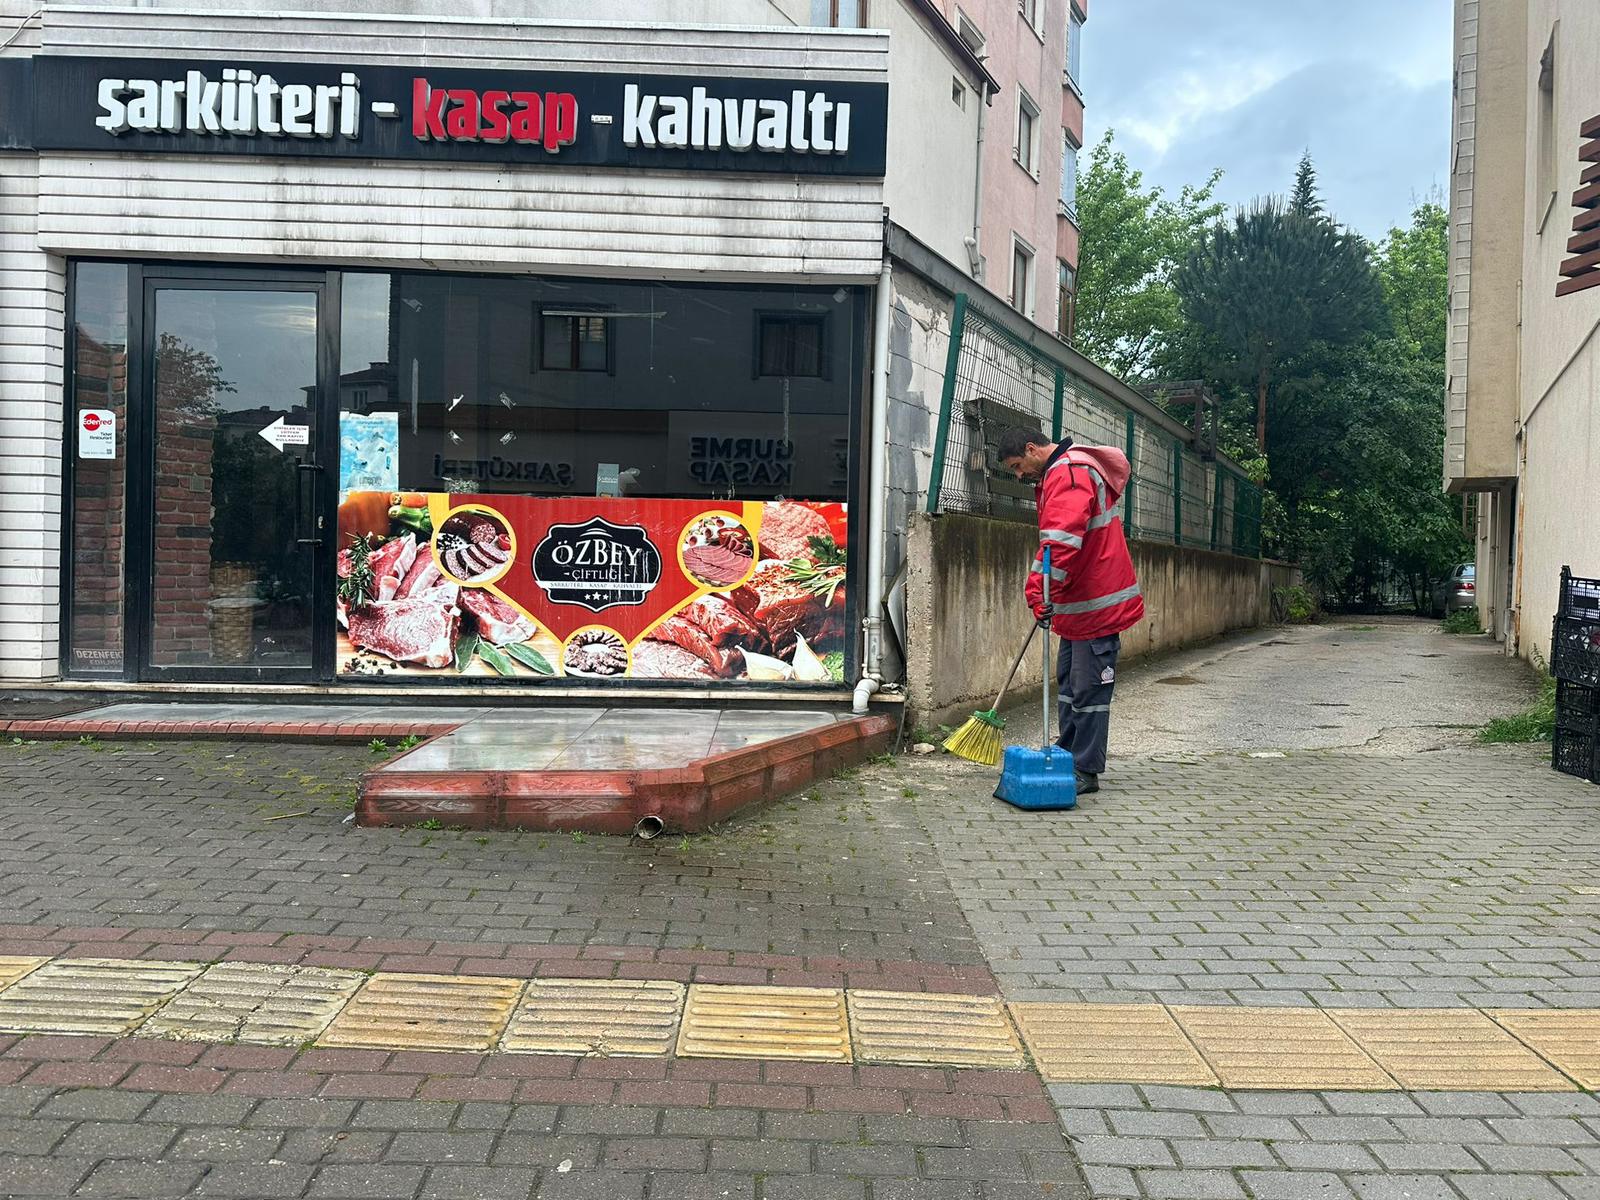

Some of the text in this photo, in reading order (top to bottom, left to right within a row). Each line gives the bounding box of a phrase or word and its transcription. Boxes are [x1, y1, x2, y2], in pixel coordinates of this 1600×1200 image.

[96, 68, 358, 137] şarküteri
[412, 77, 578, 153] kasap
[623, 84, 851, 153] kahvaltı
[83, 418, 112, 426] Edenred
[551, 539, 642, 566] ÖZBEY
